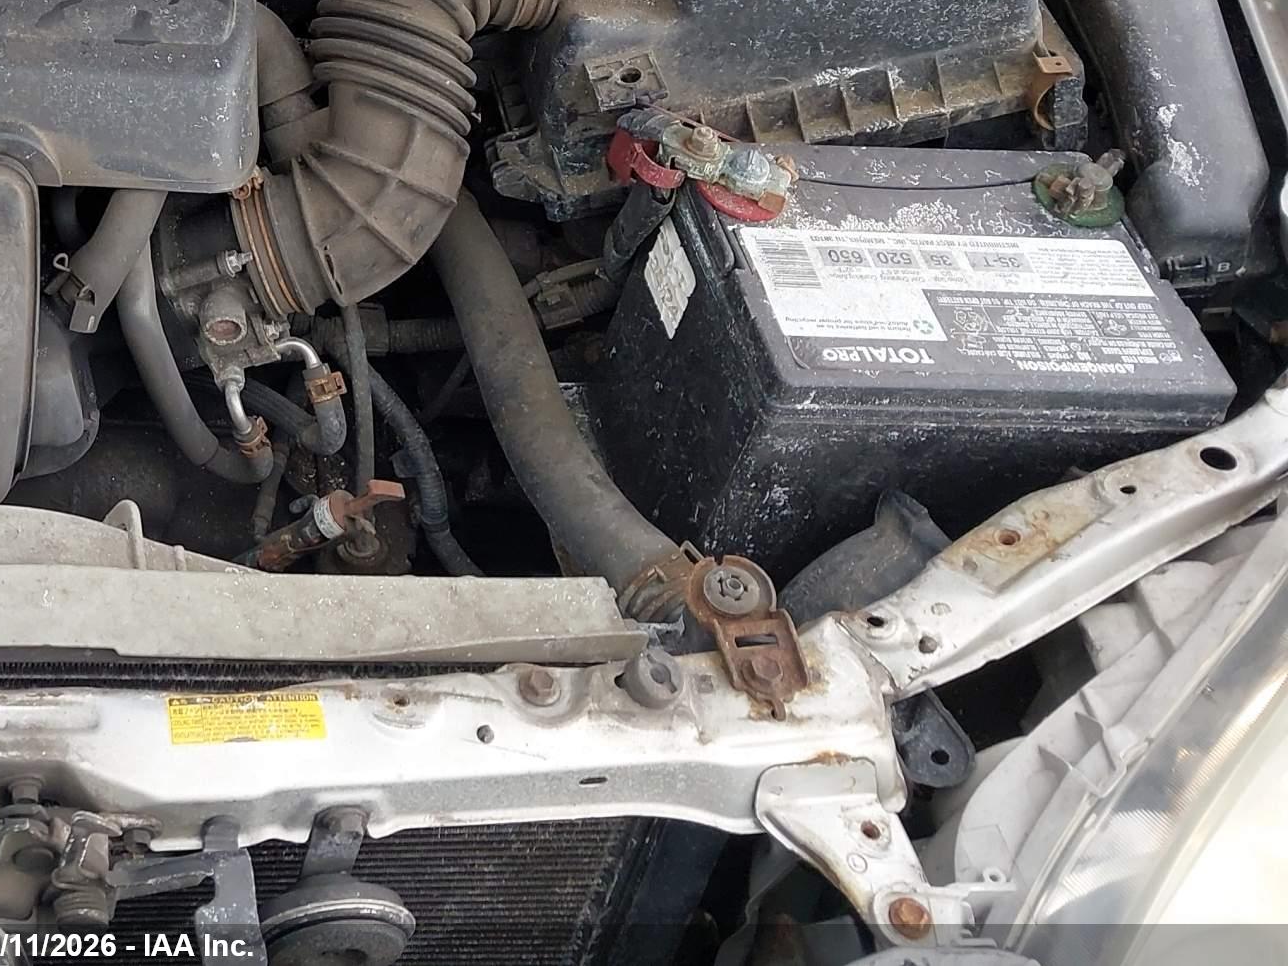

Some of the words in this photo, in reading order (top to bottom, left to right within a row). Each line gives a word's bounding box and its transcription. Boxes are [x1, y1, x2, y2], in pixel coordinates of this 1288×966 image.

[827, 249, 862, 264] 650
[877, 251, 912, 265] 520
[930, 253, 952, 266] 35
[983, 255, 1020, 268] 35-T
[822, 345, 936, 365] TOTALPRO
